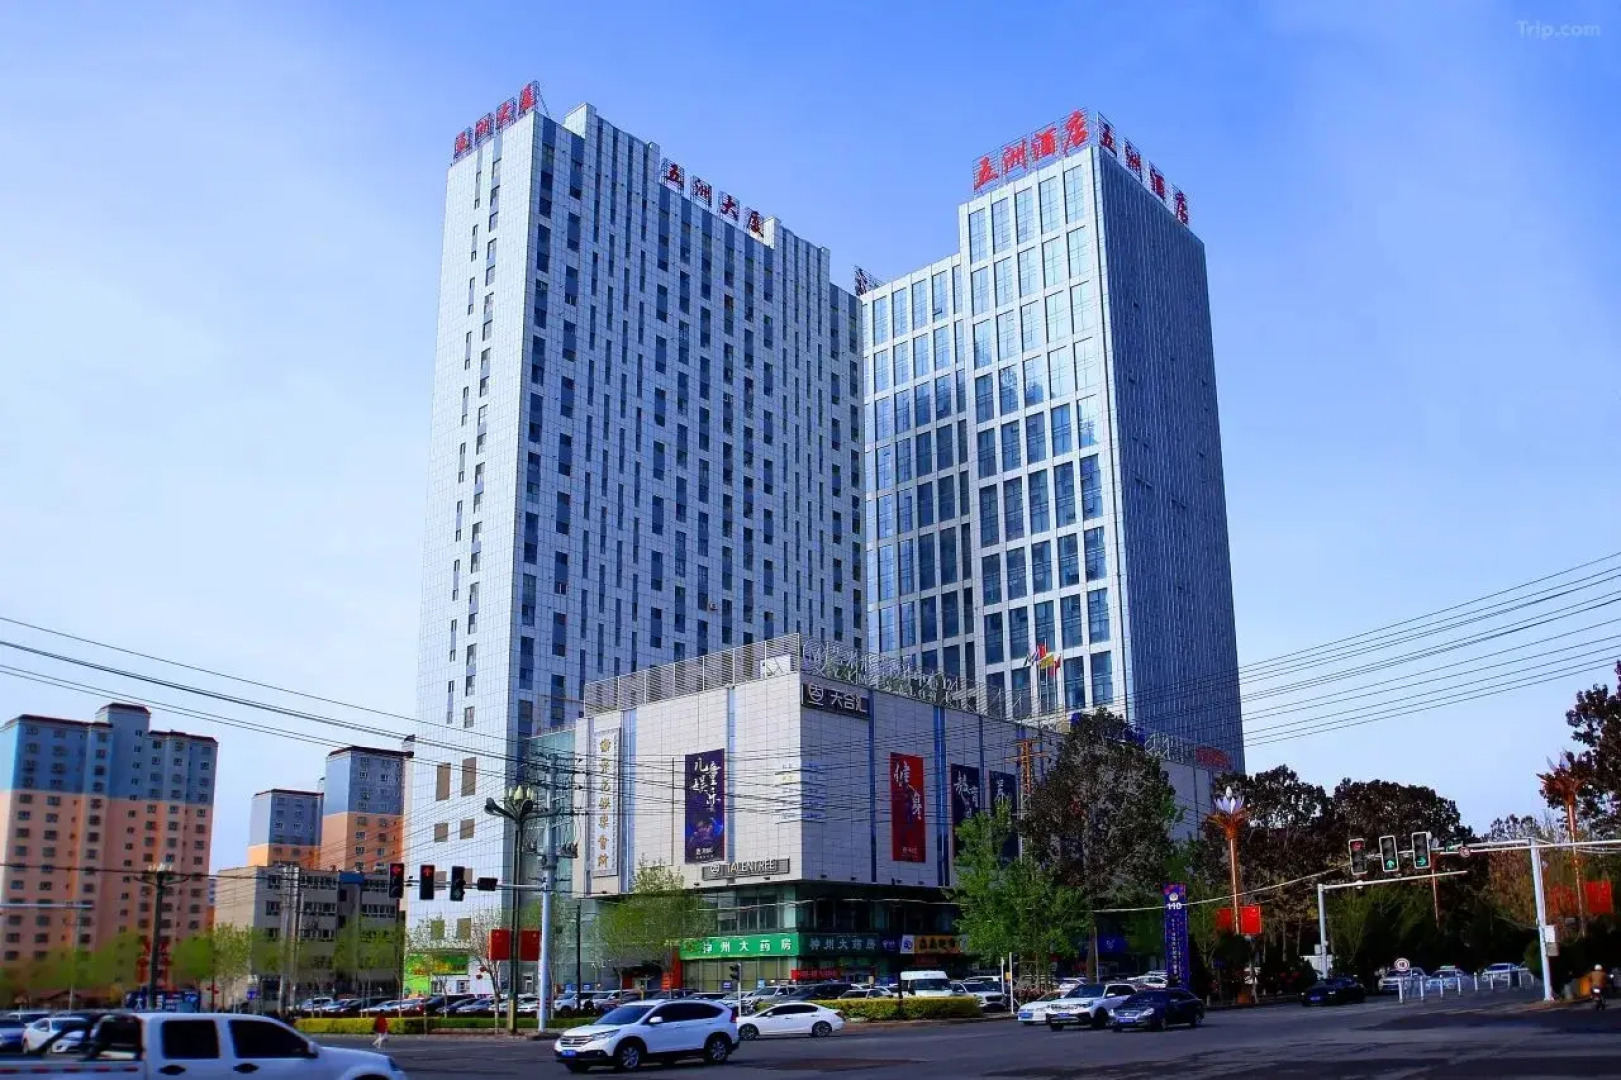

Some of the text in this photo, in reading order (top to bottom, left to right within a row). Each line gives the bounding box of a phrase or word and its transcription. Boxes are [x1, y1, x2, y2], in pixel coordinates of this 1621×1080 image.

[974, 109, 1089, 190] 五洲酒店
[702, 937, 792, 954] 神州大药房
